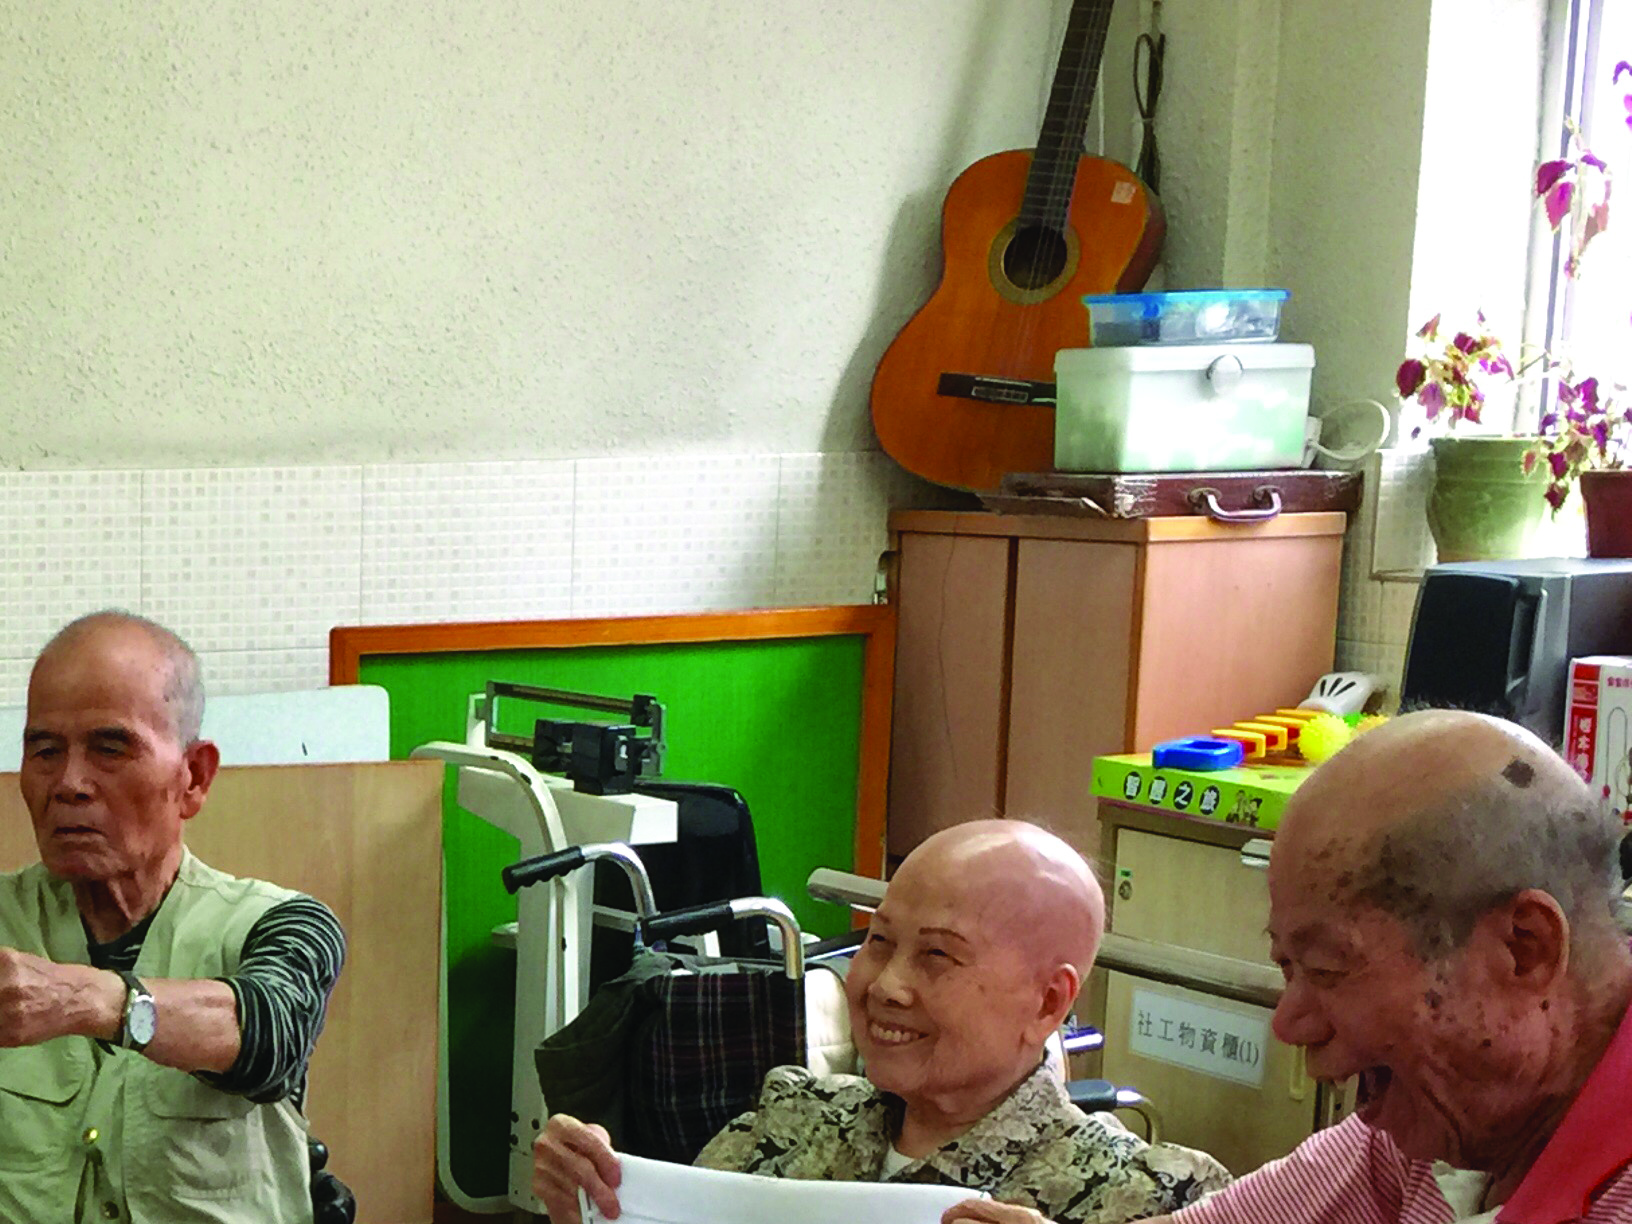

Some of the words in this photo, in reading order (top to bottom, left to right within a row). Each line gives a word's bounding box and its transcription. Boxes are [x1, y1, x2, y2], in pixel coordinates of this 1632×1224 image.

[1137, 1010, 1260, 1068] 社工物資櫃(1)
